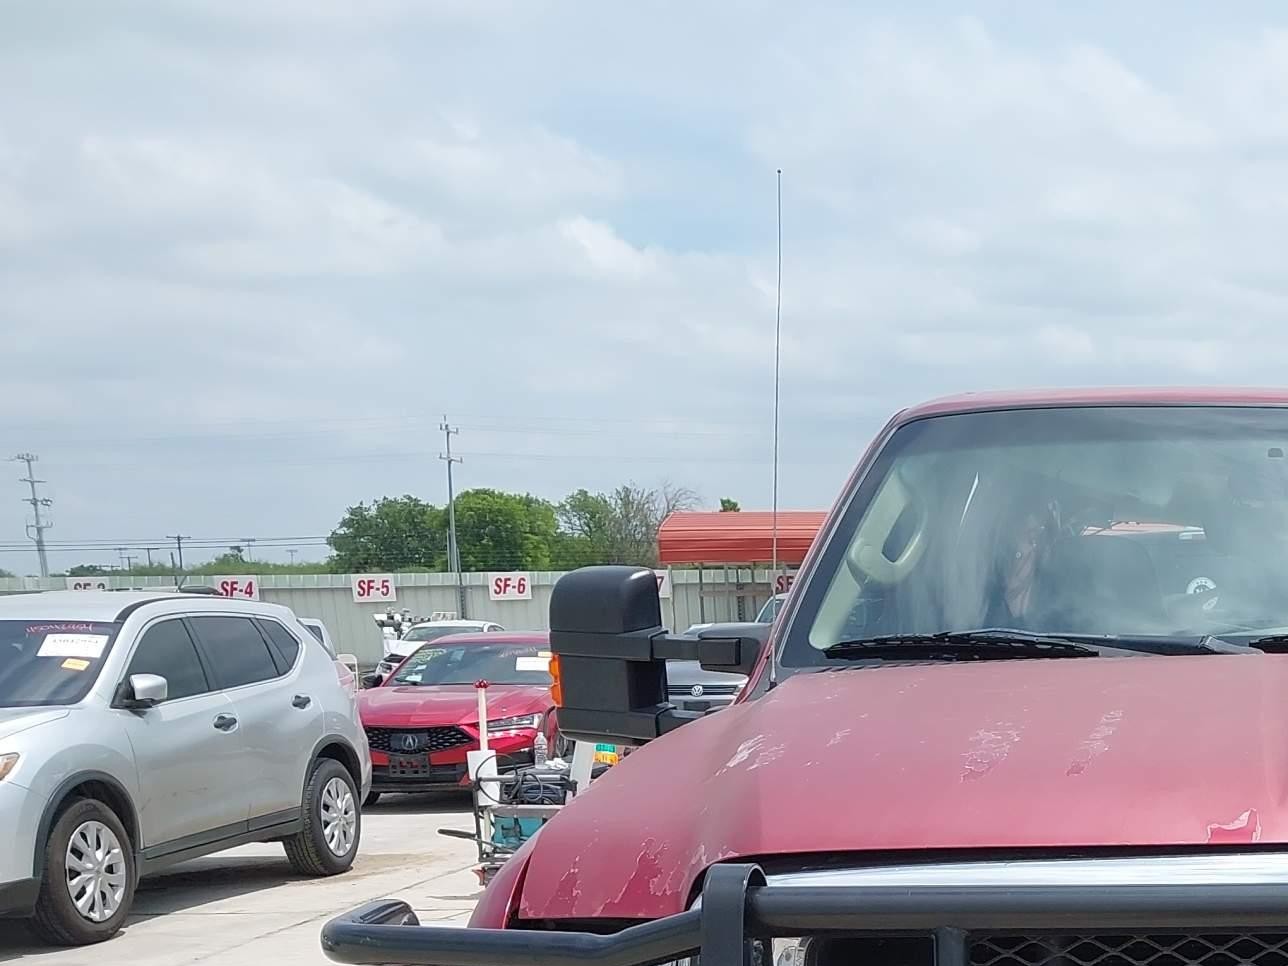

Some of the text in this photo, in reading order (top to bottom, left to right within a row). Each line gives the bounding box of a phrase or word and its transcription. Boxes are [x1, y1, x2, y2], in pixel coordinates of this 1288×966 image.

[220, 580, 254, 598] SF-4
[357, 579, 390, 597] SF-5
[493, 577, 526, 595] SF-6
